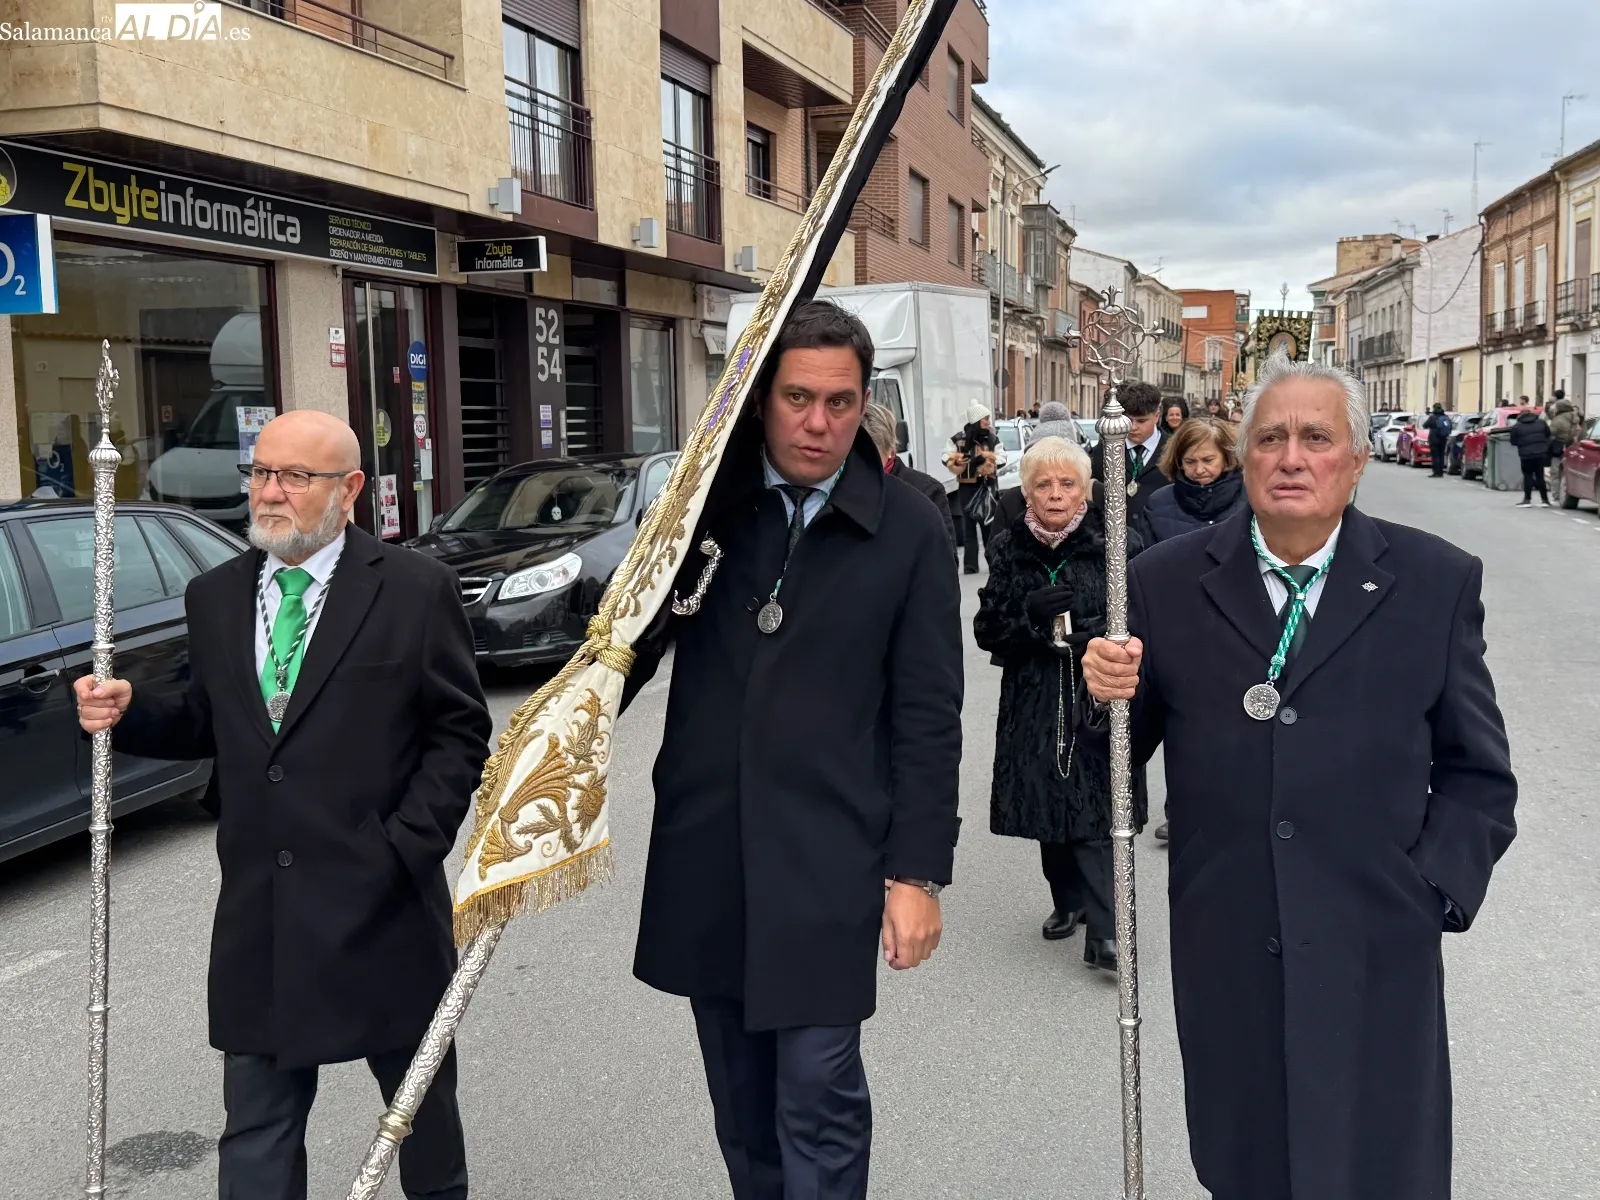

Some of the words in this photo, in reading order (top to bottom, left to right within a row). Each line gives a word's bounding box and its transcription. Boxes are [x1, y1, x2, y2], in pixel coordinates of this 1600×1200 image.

[329, 215, 350, 226] SERVICIO
[329, 226, 360, 238] ORDENADOR
[366, 234, 384, 243] MEDIDA
[329, 248, 349, 260] DISEÑO
[353, 253, 392, 265] MANTENIMIENTO
[392, 259, 403, 267] WEB
[362, 243, 368, 252] DE
[368, 245, 403, 257] SMARTPHONES
[407, 251, 426, 261] TABLETS
[485, 242, 513, 257] Zbyte
[475, 256, 524, 269] informática
[535, 306, 560, 345] 52
[410, 353, 426, 365] DIGI
[537, 346, 562, 383] 54
